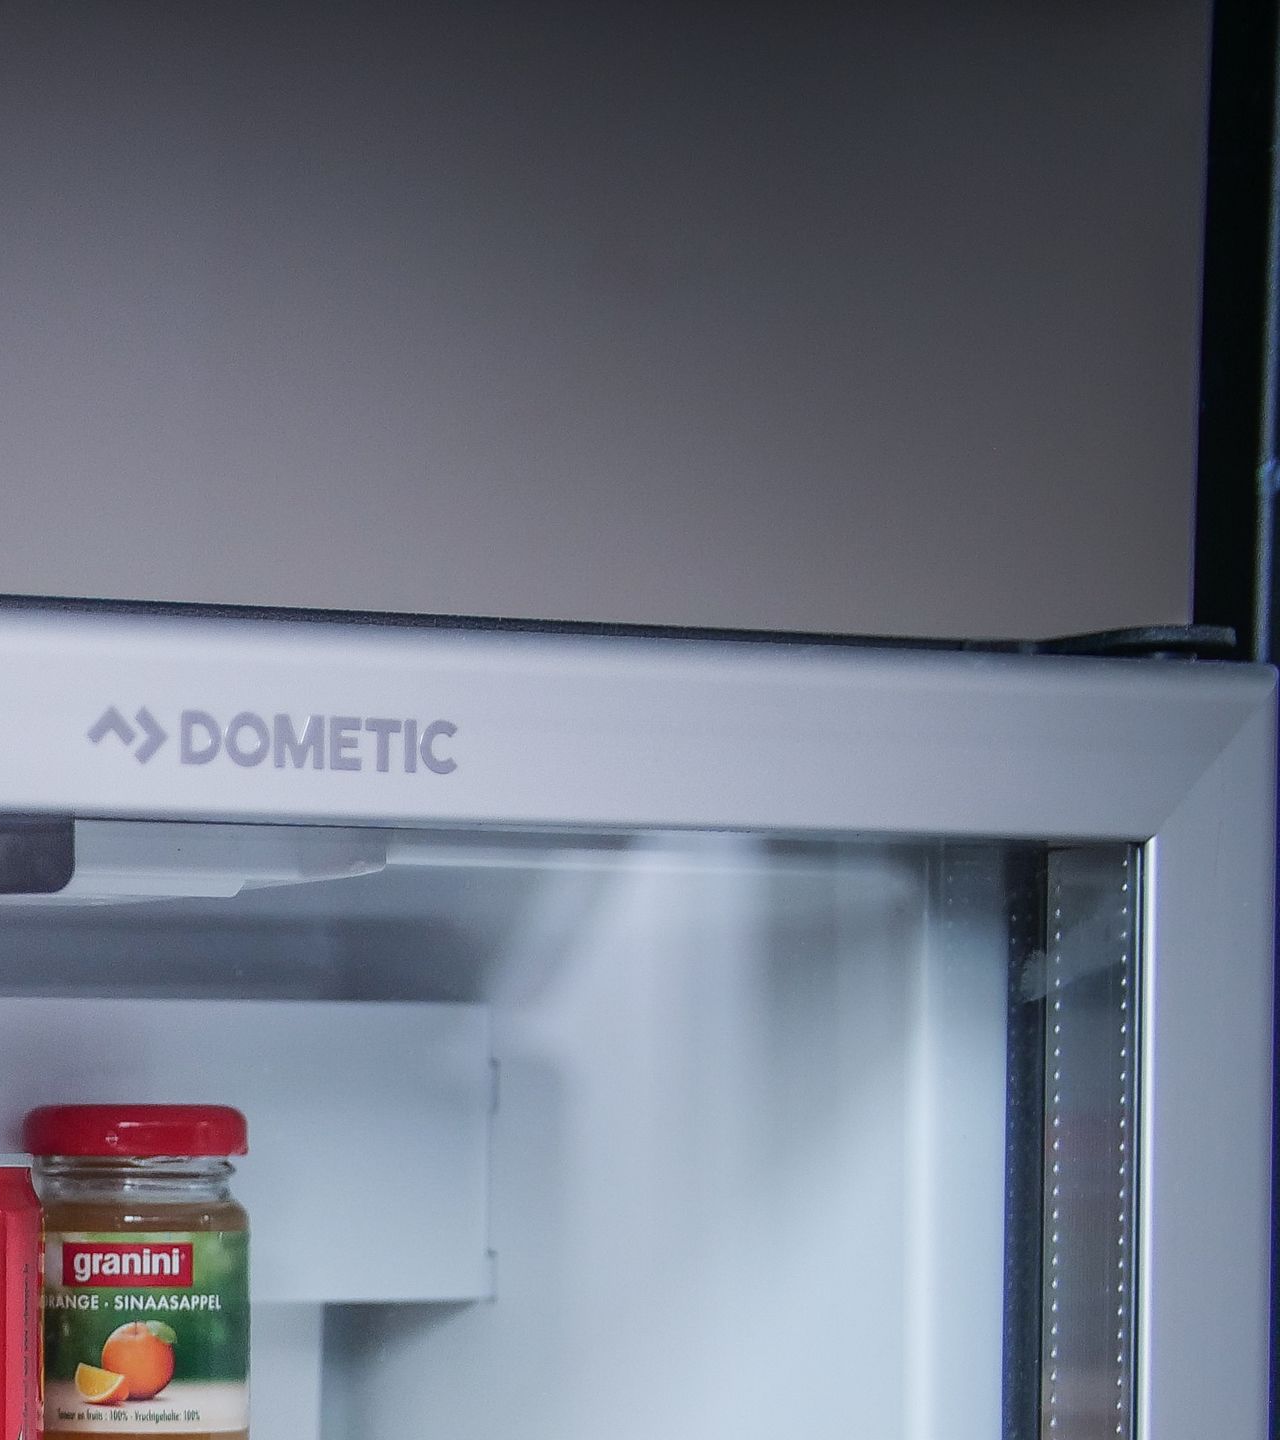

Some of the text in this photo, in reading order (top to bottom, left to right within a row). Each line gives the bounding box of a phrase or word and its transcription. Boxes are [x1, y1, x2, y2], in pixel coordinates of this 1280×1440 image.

[180, 709, 458, 775] DOMETIC
[73, 1248, 180, 1282] granini
[113, 1294, 222, 1311] SINAASAPPEL
